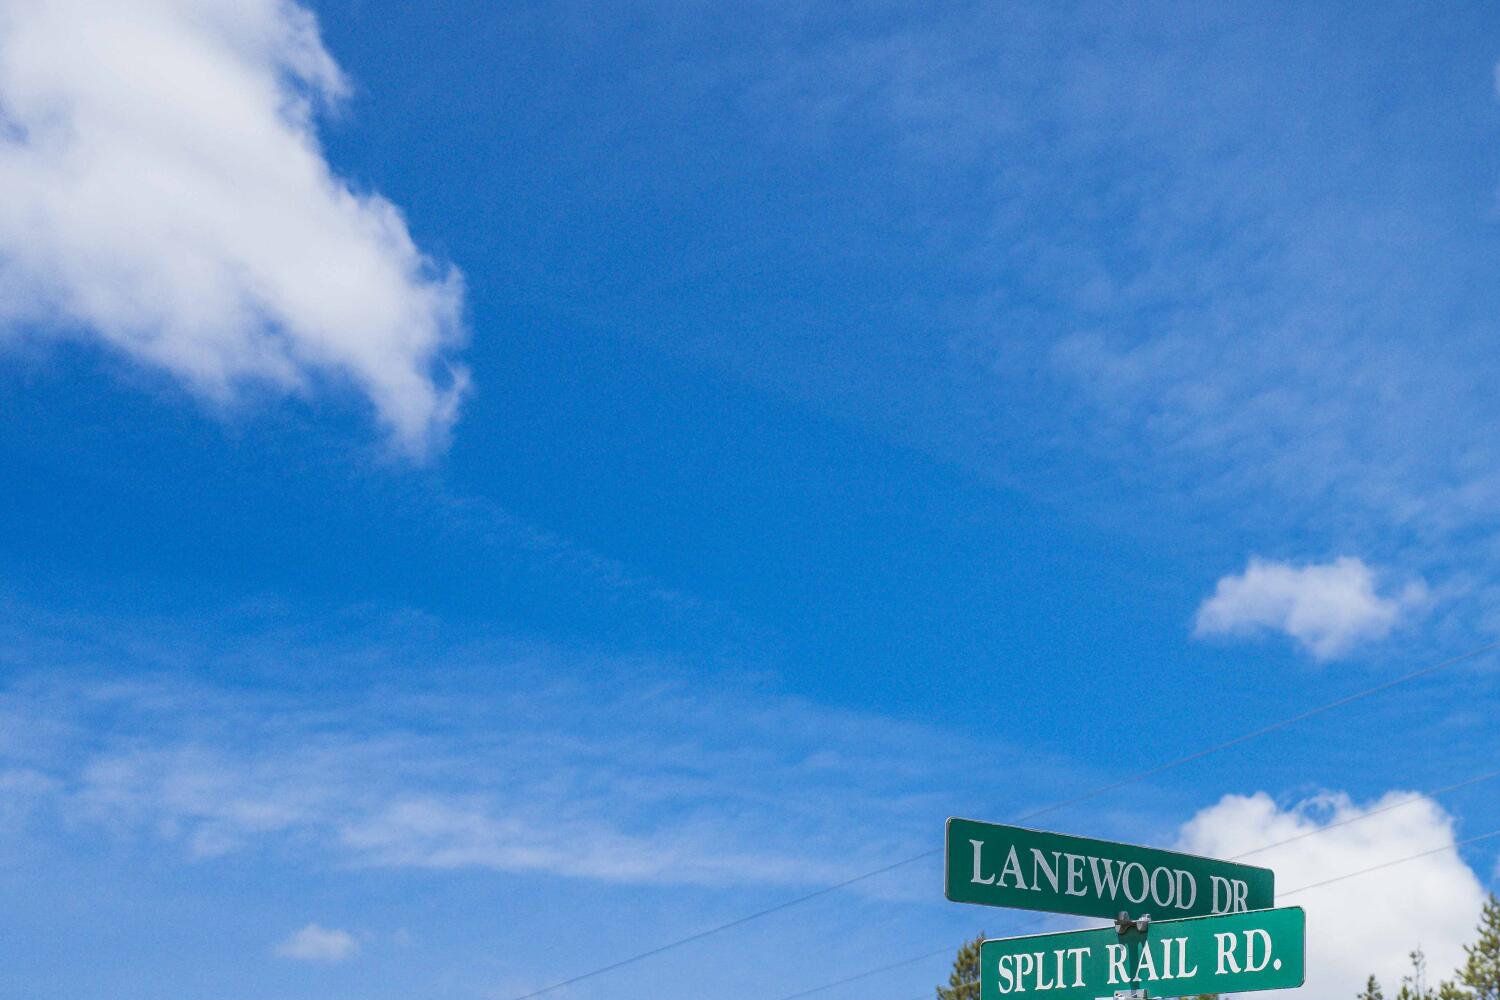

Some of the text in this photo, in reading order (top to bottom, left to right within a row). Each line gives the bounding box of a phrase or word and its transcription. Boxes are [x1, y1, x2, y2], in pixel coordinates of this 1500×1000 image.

[968, 838, 1249, 914] LANEWOOD DR
[998, 928, 1282, 994] SPLIT RAIL RD.
